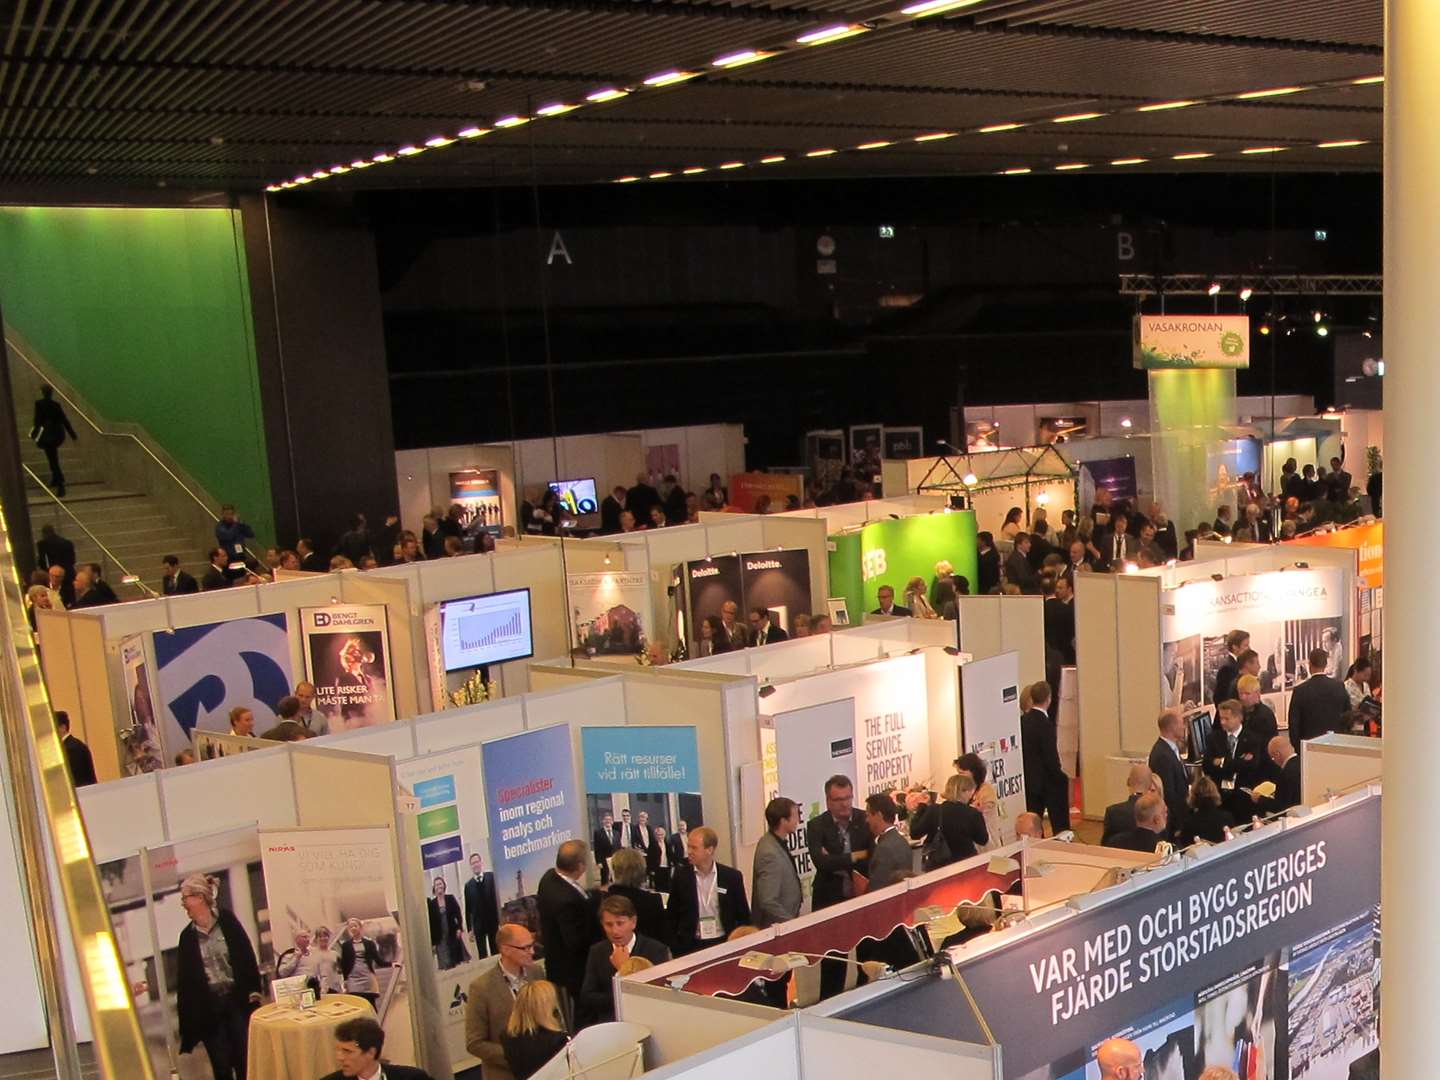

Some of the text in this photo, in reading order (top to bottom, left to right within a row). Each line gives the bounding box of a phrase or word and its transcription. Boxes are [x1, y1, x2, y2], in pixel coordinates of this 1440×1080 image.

[547, 231, 572, 265] A
[1118, 233, 1135, 260] B
[1148, 322, 1223, 333] VASAKRONAN
[691, 567, 721, 579] Deloitte.
[746, 561, 782, 571] Deloitte.
[332, 617, 374, 626] DAHLGREN
[317, 695, 348, 705] MÅSTE
[337, 685, 369, 695] RISKER
[349, 696, 371, 705] MAN
[864, 711, 906, 738] THE FULL
[603, 751, 677, 765] Rätt resurser
[865, 734, 903, 761] SERVICE
[598, 765, 686, 780] vid rätt tillfälle!
[866, 753, 913, 783] PROPERTY
[499, 792, 564, 822] inom regional
[502, 814, 553, 841] analys och
[504, 829, 573, 860] benchmarking
[1028, 840, 1327, 995] VAR MED OCH BYGG SVERIGES
[1050, 959, 1133, 1026] FJÄRDE
[1138, 878, 1314, 985] STORSTADSREGION
